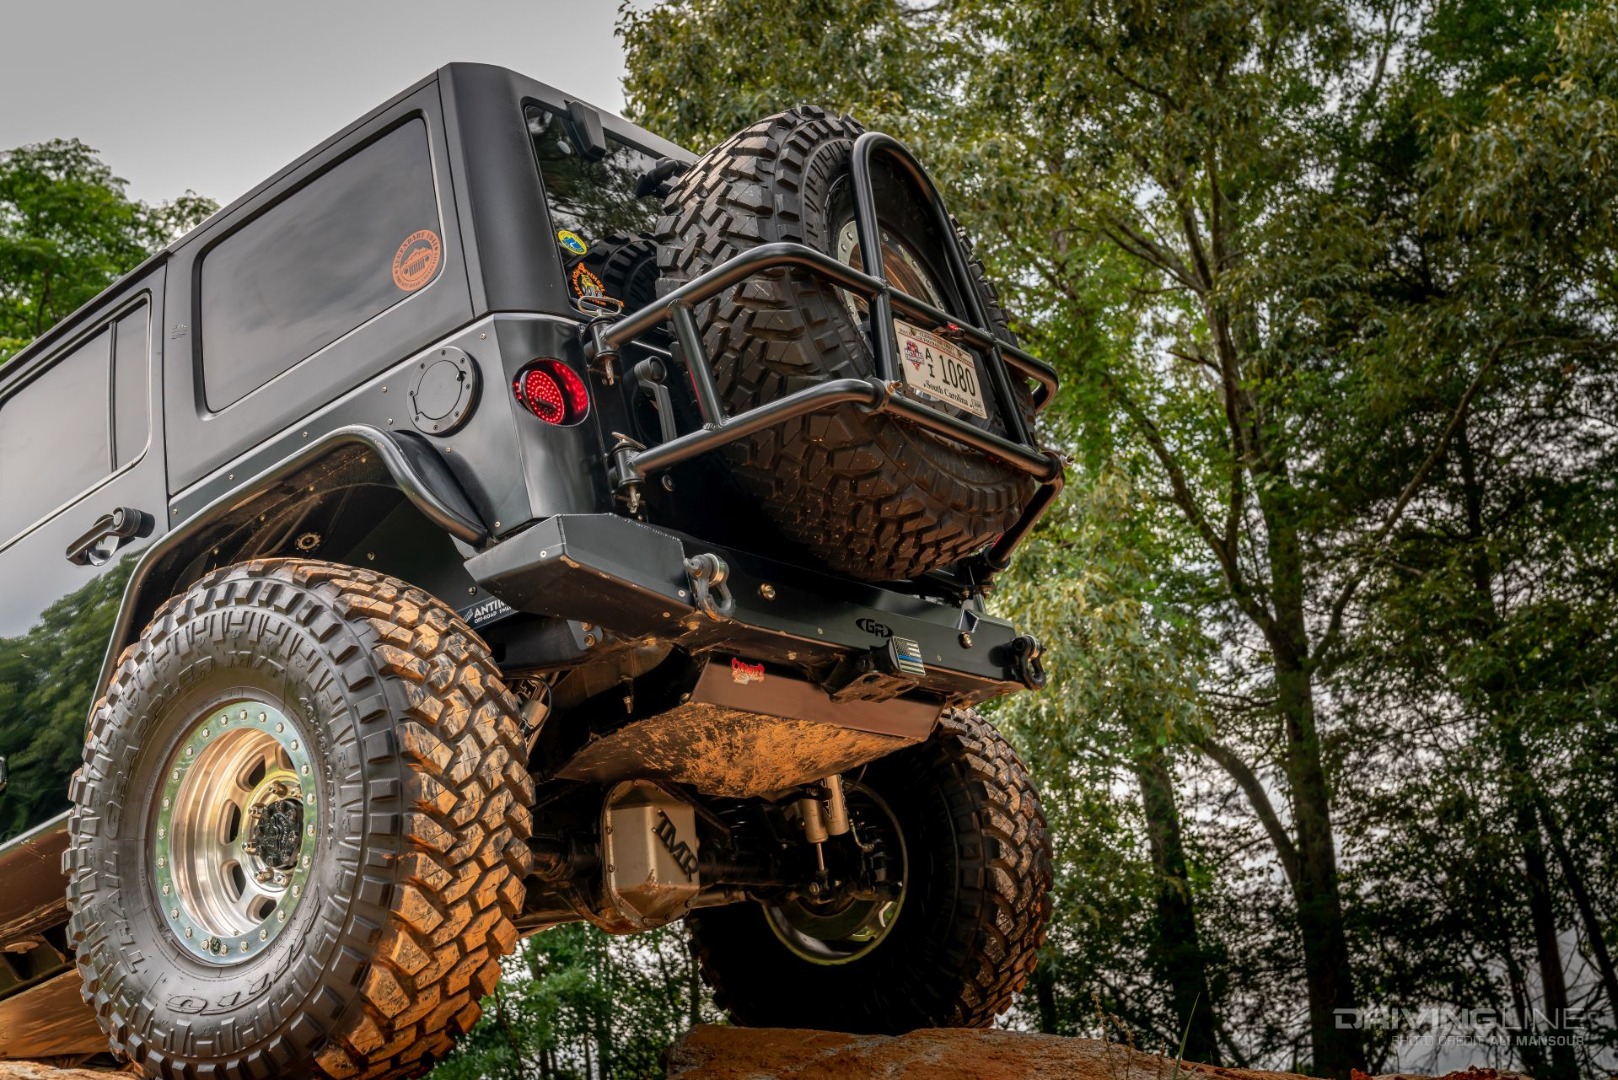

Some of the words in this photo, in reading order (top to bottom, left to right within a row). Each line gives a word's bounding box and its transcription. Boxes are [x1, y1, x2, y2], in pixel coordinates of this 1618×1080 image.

[926, 379, 944, 395] South
[944, 388, 970, 406] Carolina
[939, 354, 976, 397] 1080
